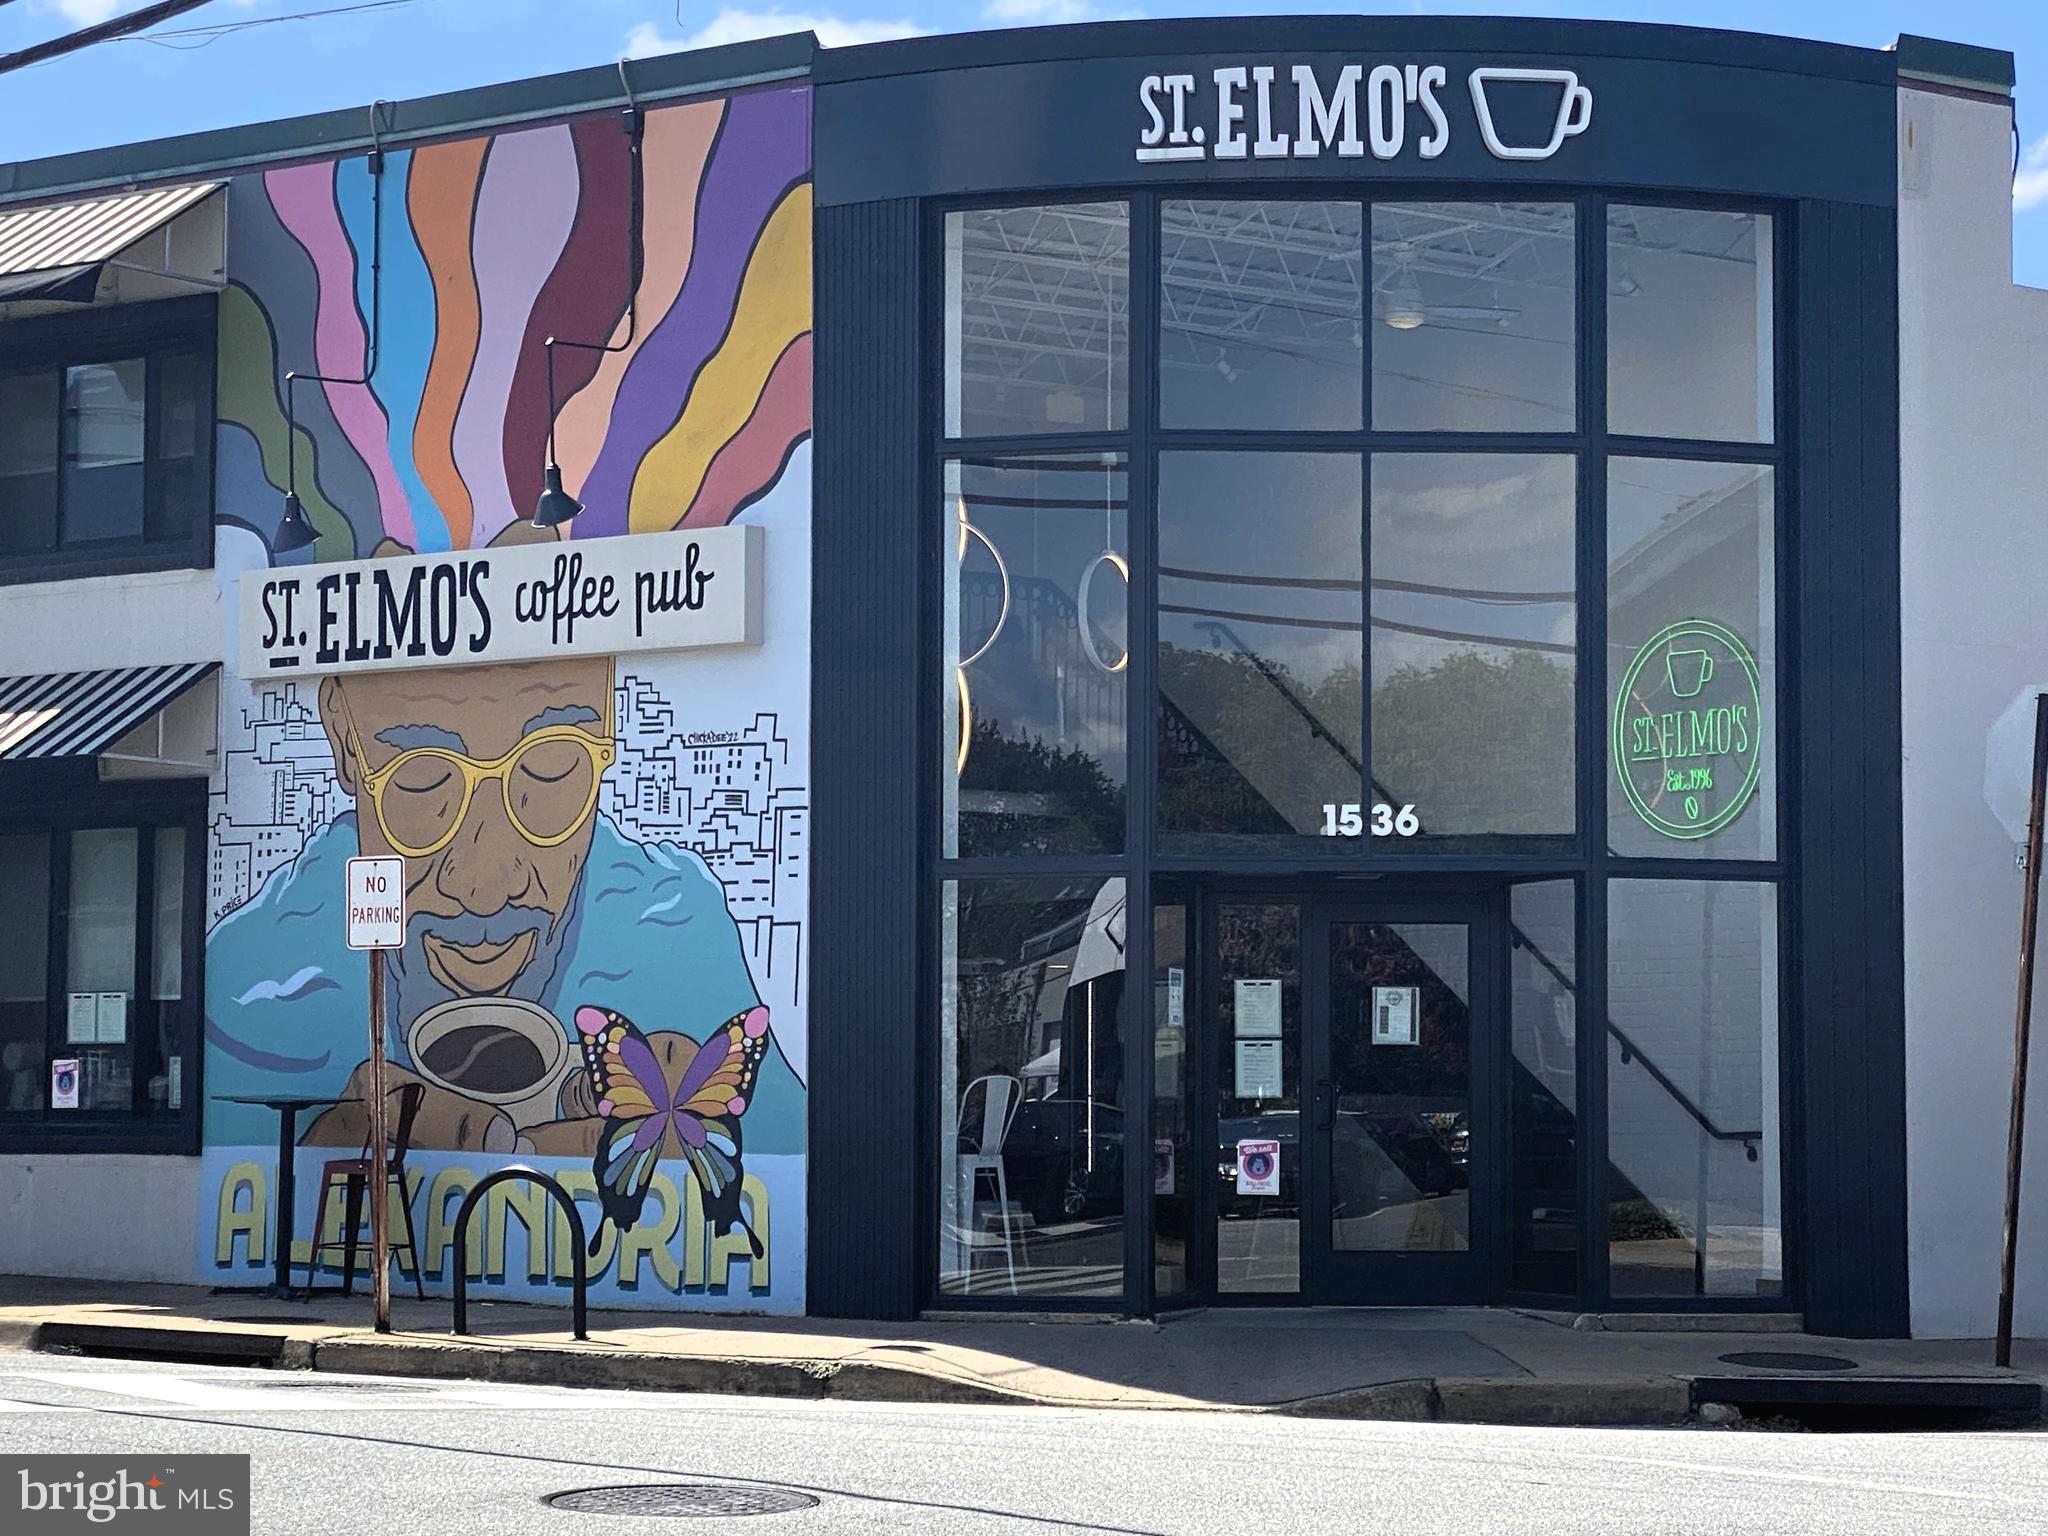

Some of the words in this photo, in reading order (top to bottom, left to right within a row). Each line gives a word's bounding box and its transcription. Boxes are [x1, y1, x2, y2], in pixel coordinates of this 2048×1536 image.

[1136, 74, 1206, 146] ST.
[1213, 64, 1450, 161] ELMO'S
[262, 580, 308, 650] ST.
[315, 560, 492, 665] ELMO'S
[514, 552, 620, 645] coffee
[634, 542, 715, 638] pub
[1661, 704, 1749, 759] ELMO'S
[1322, 803, 1420, 837] 1536
[366, 876, 387, 893] NO
[352, 907, 400, 924] PARKING
[215, 1162, 771, 1297] AEXANDRIA
